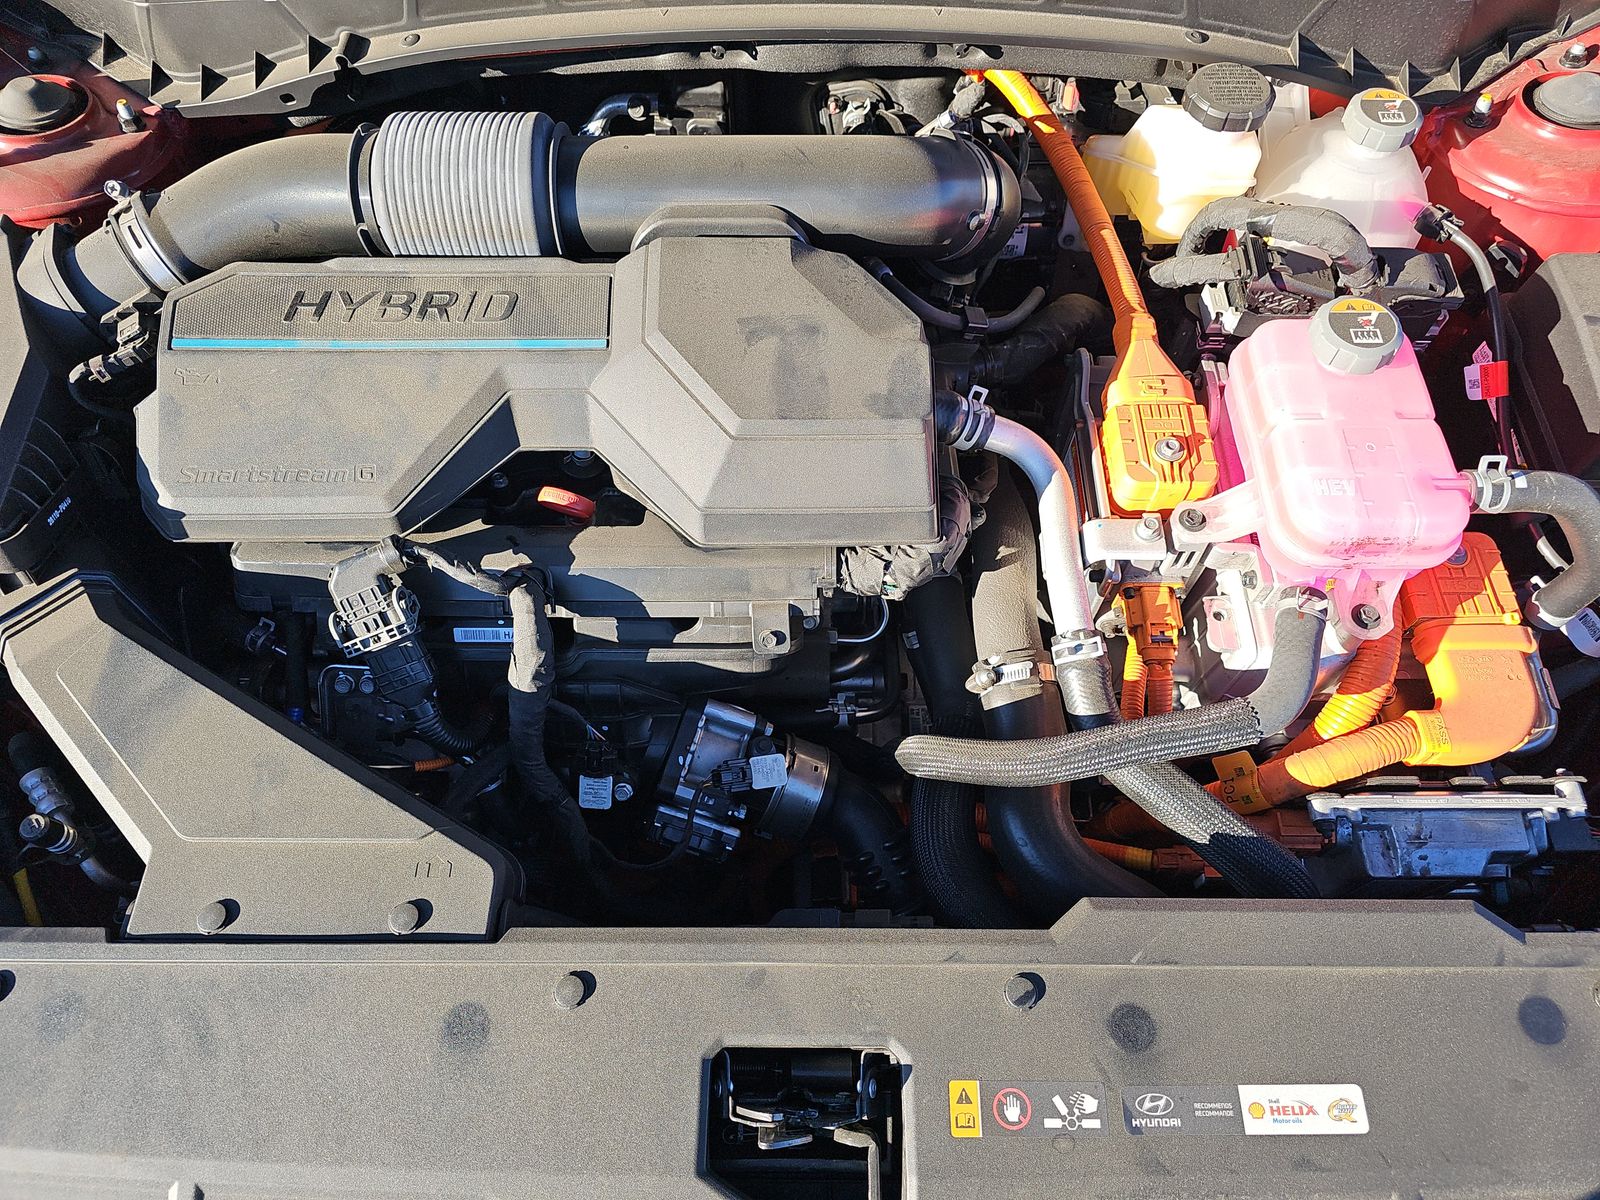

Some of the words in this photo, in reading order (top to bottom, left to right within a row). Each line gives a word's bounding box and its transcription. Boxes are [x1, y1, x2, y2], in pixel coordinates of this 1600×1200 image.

[283, 290, 519, 323] HYBRID
[178, 465, 349, 484] Smartstream
[1222, 777, 1240, 804] PC1
[1269, 1105, 1317, 1117] HELIX
[1132, 1117, 1182, 1128] HYUNDAI
[1272, 1117, 1290, 1125] Motor
[1291, 1117, 1303, 1125] oils
